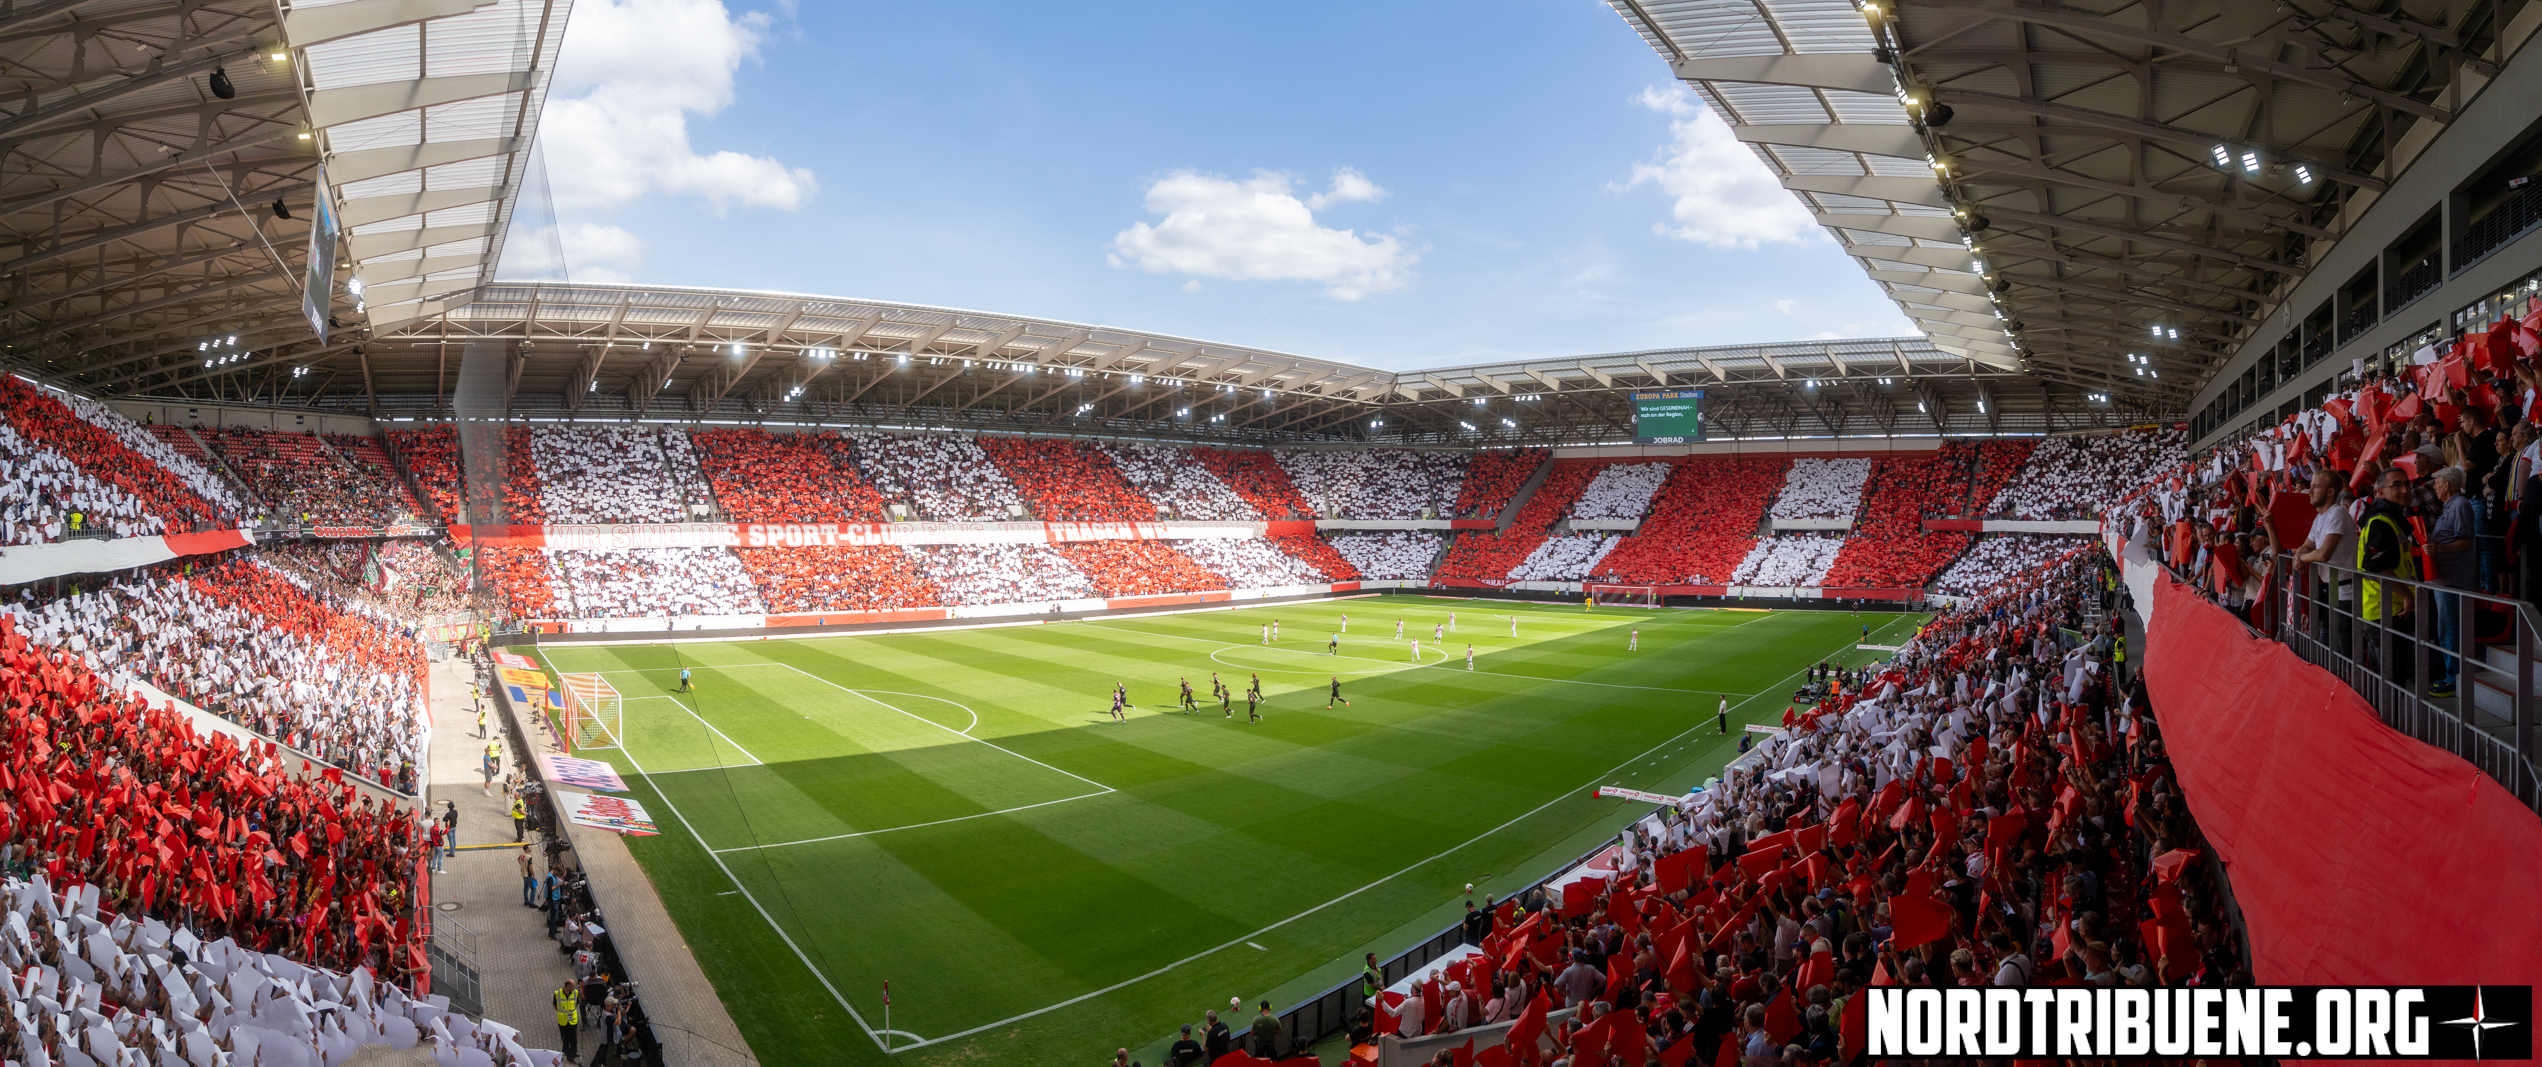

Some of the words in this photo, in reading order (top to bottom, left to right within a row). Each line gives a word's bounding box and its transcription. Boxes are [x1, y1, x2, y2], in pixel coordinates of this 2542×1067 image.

[313, 526, 378, 537] ORIGINAL
[544, 525, 601, 550] WIR
[611, 524, 682, 549] SIND
[691, 523, 741, 547] DIE
[1050, 521, 1133, 542] TRAGEN
